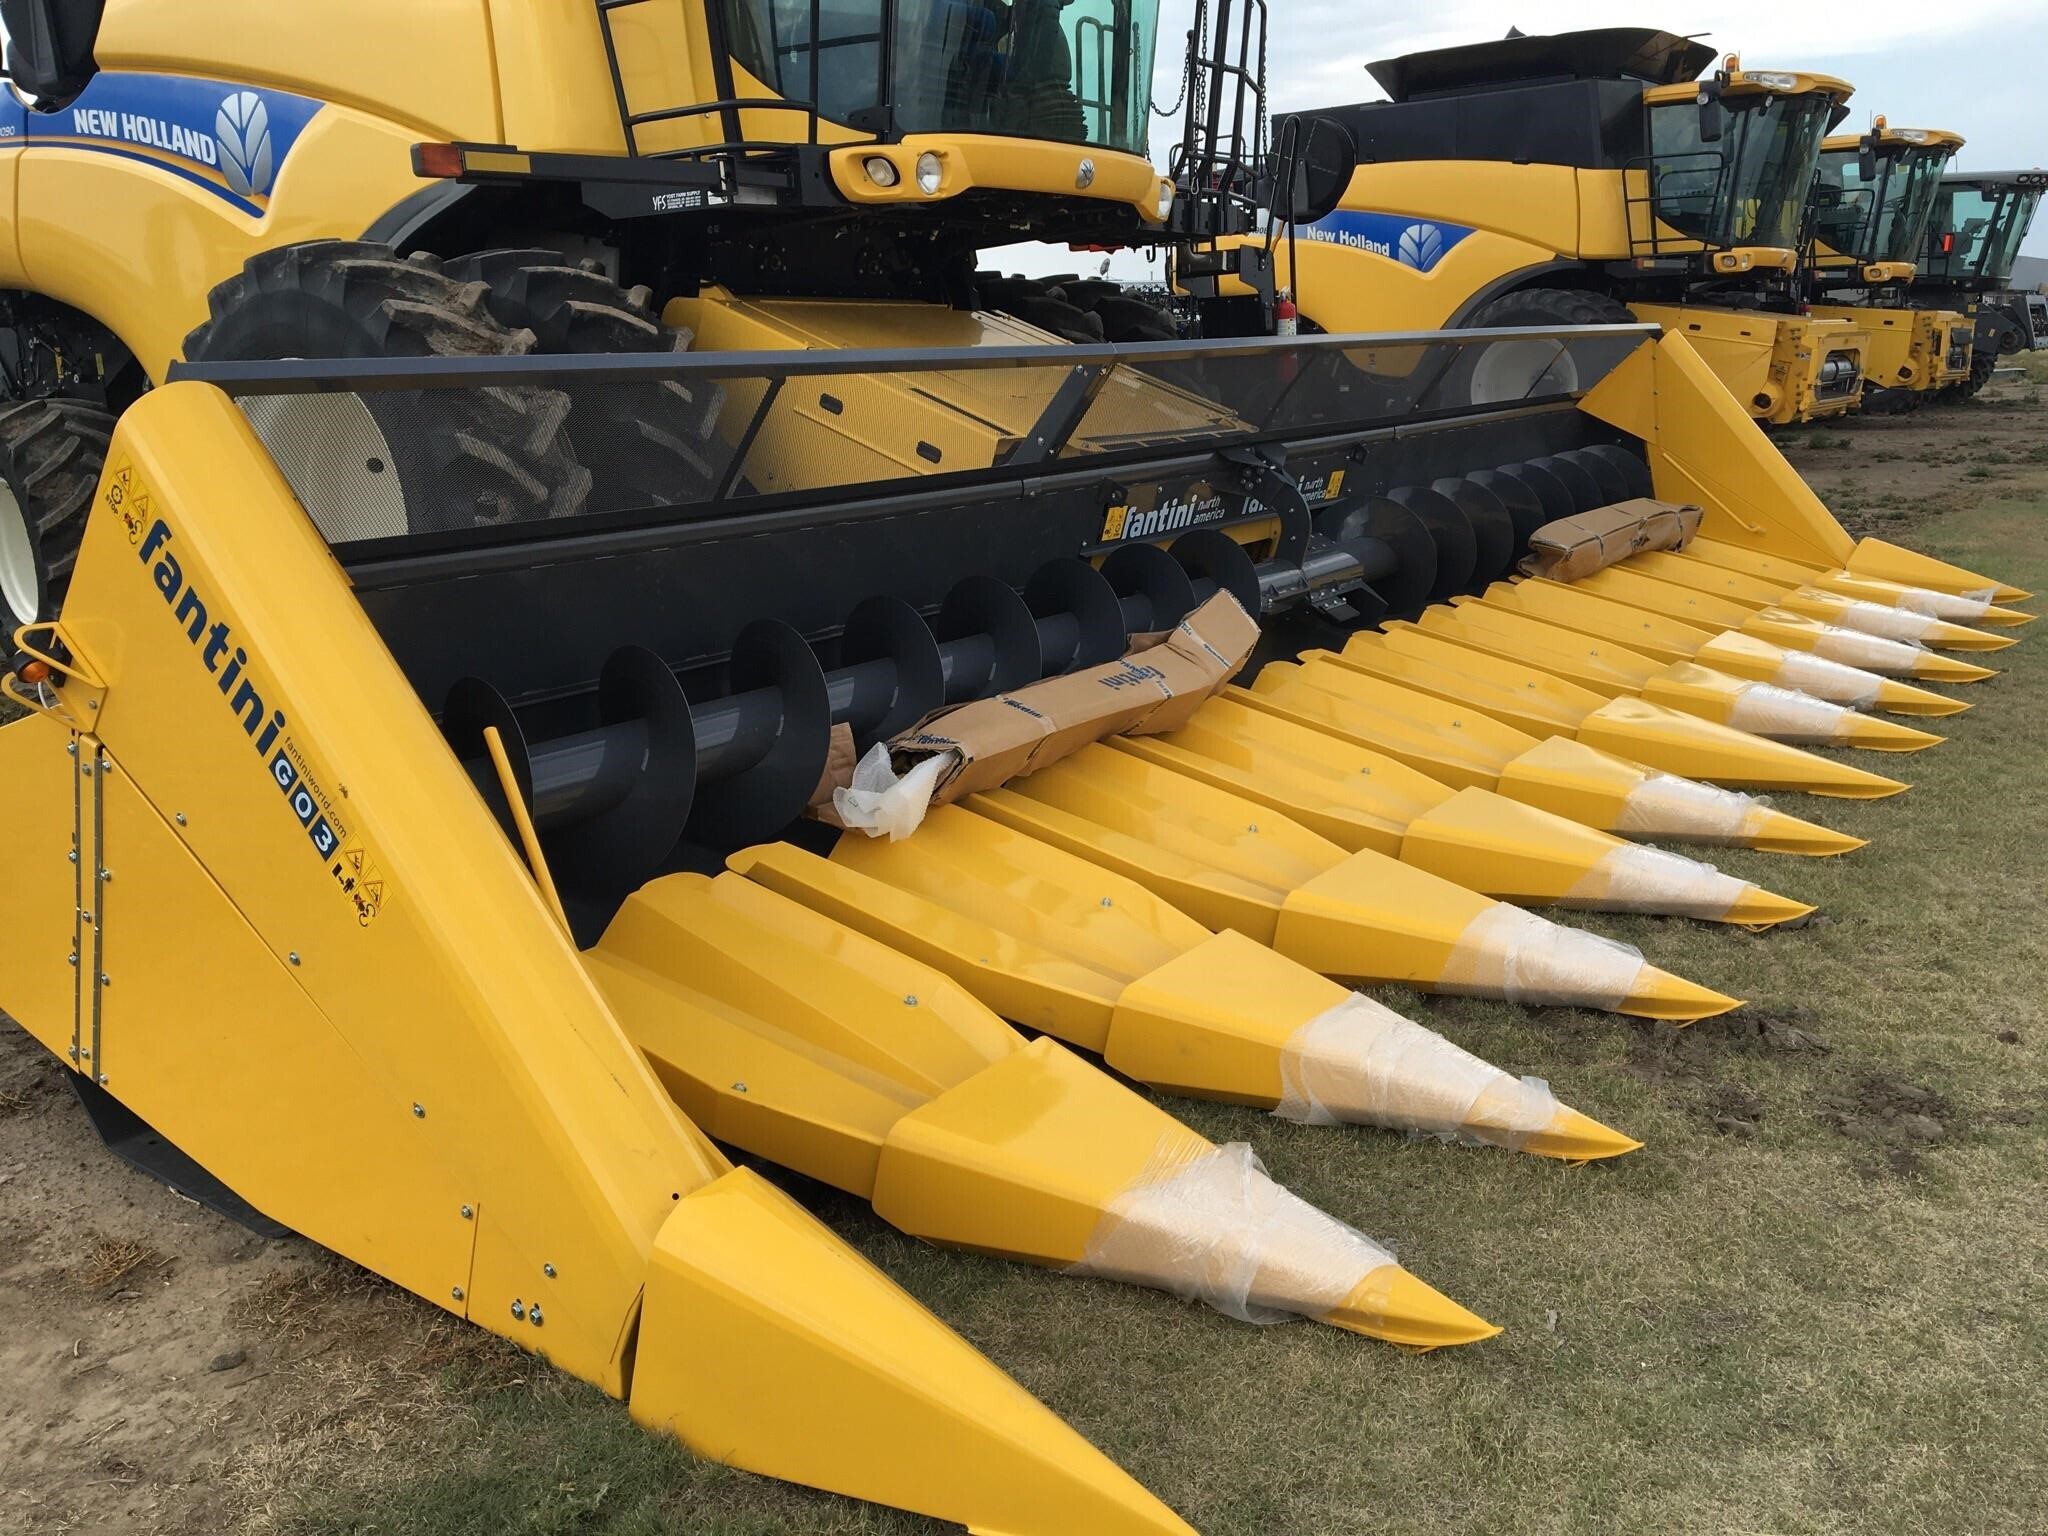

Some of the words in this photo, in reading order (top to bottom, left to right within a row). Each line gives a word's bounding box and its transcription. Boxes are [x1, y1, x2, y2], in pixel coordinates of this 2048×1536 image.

[73, 108, 117, 137] NEW
[124, 113, 217, 165] HOLLAND
[652, 195, 666, 211] YFS
[1307, 226, 1336, 243] New
[1339, 230, 1390, 257] Holland
[105, 494, 118, 514] STOP
[1121, 494, 1198, 540] fantini
[1193, 507, 1226, 525] america
[138, 519, 286, 757] fantini
[284, 736, 347, 838] fantiniworld.com
